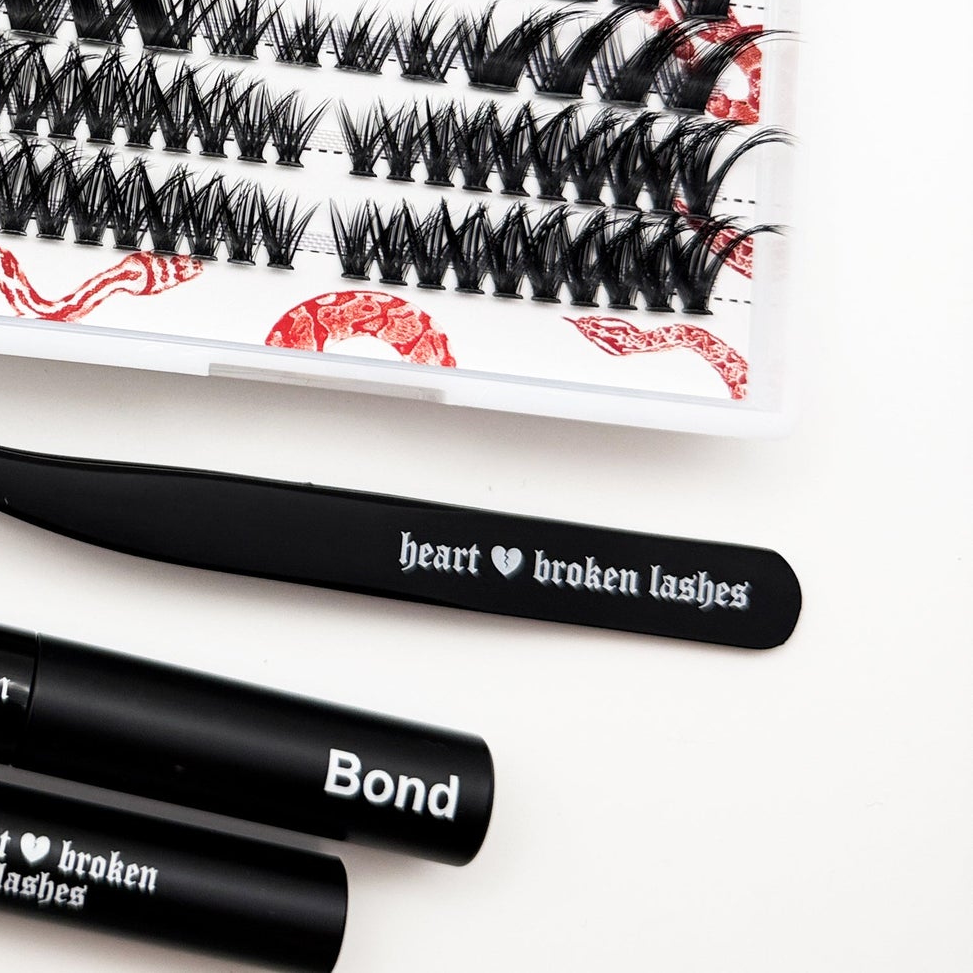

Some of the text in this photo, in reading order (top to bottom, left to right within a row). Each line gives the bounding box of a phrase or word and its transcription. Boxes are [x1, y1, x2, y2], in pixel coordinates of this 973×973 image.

[399, 531, 749, 609] heart broken lashes
[324, 748, 459, 820] Bond
[58, 840, 158, 892] broken
